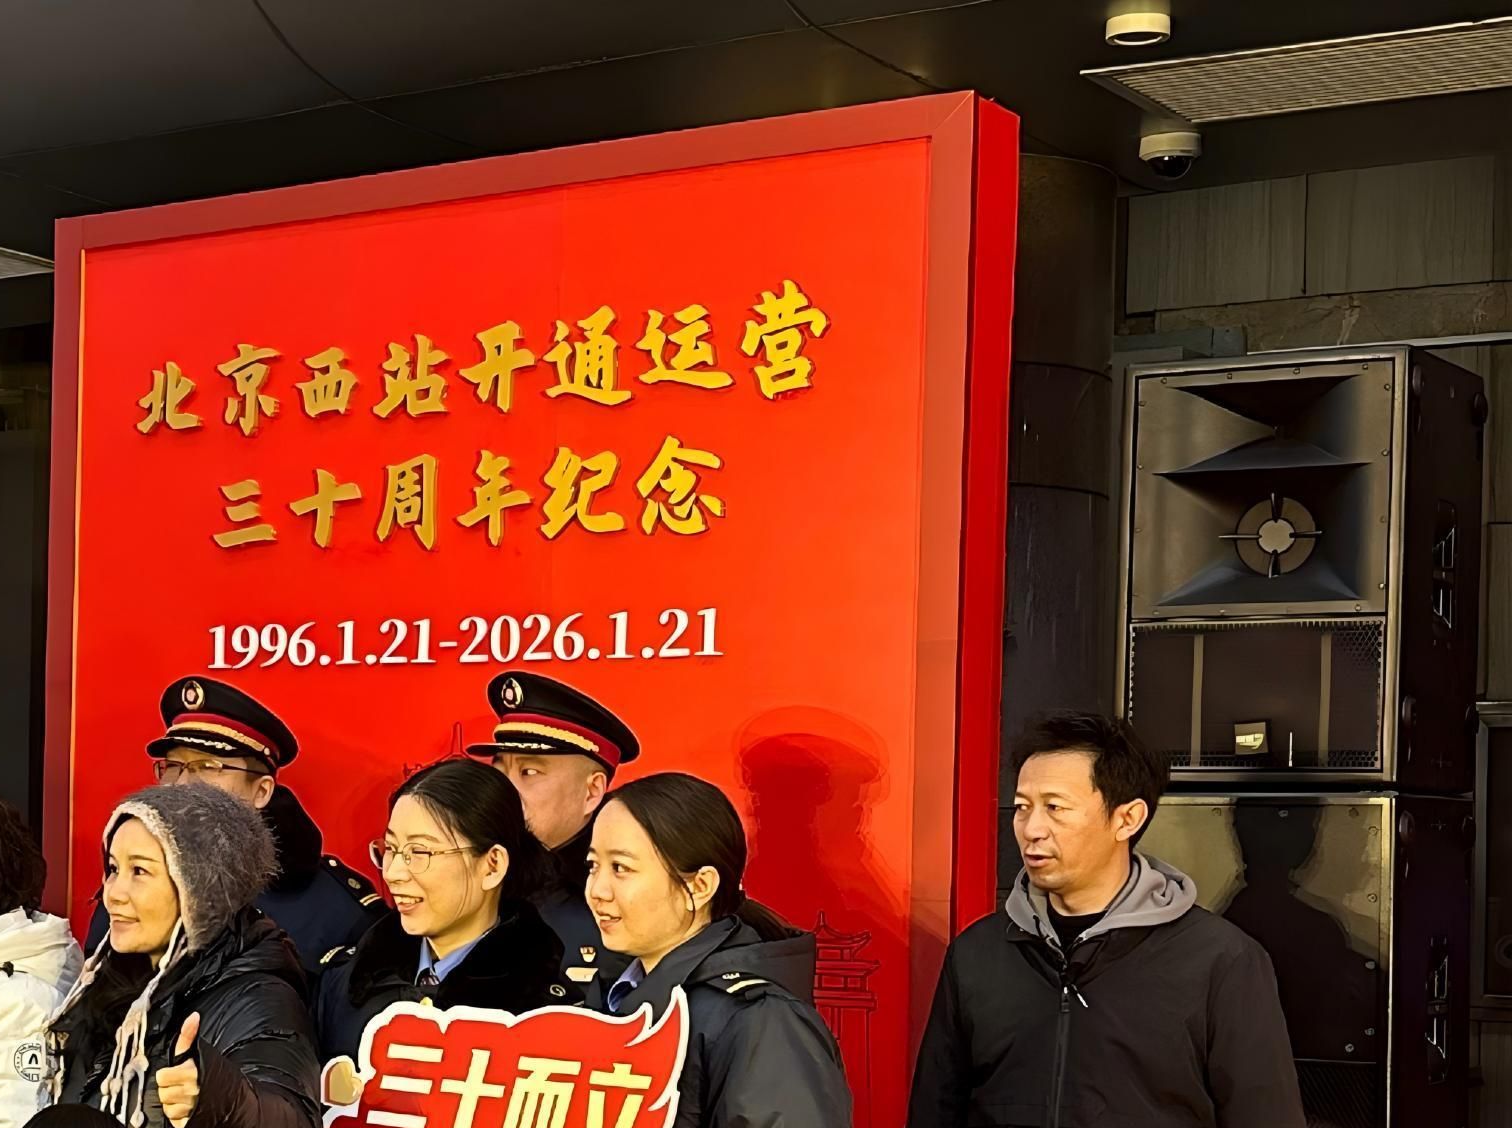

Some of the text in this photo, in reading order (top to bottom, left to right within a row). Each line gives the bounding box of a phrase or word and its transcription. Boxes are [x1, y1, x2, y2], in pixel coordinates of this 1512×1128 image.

[136, 280, 828, 436] 北京西站开通运营
[213, 436, 726, 550] 三十周年纪念
[207, 608, 724, 671] 1996.1.21-2026.1.21
